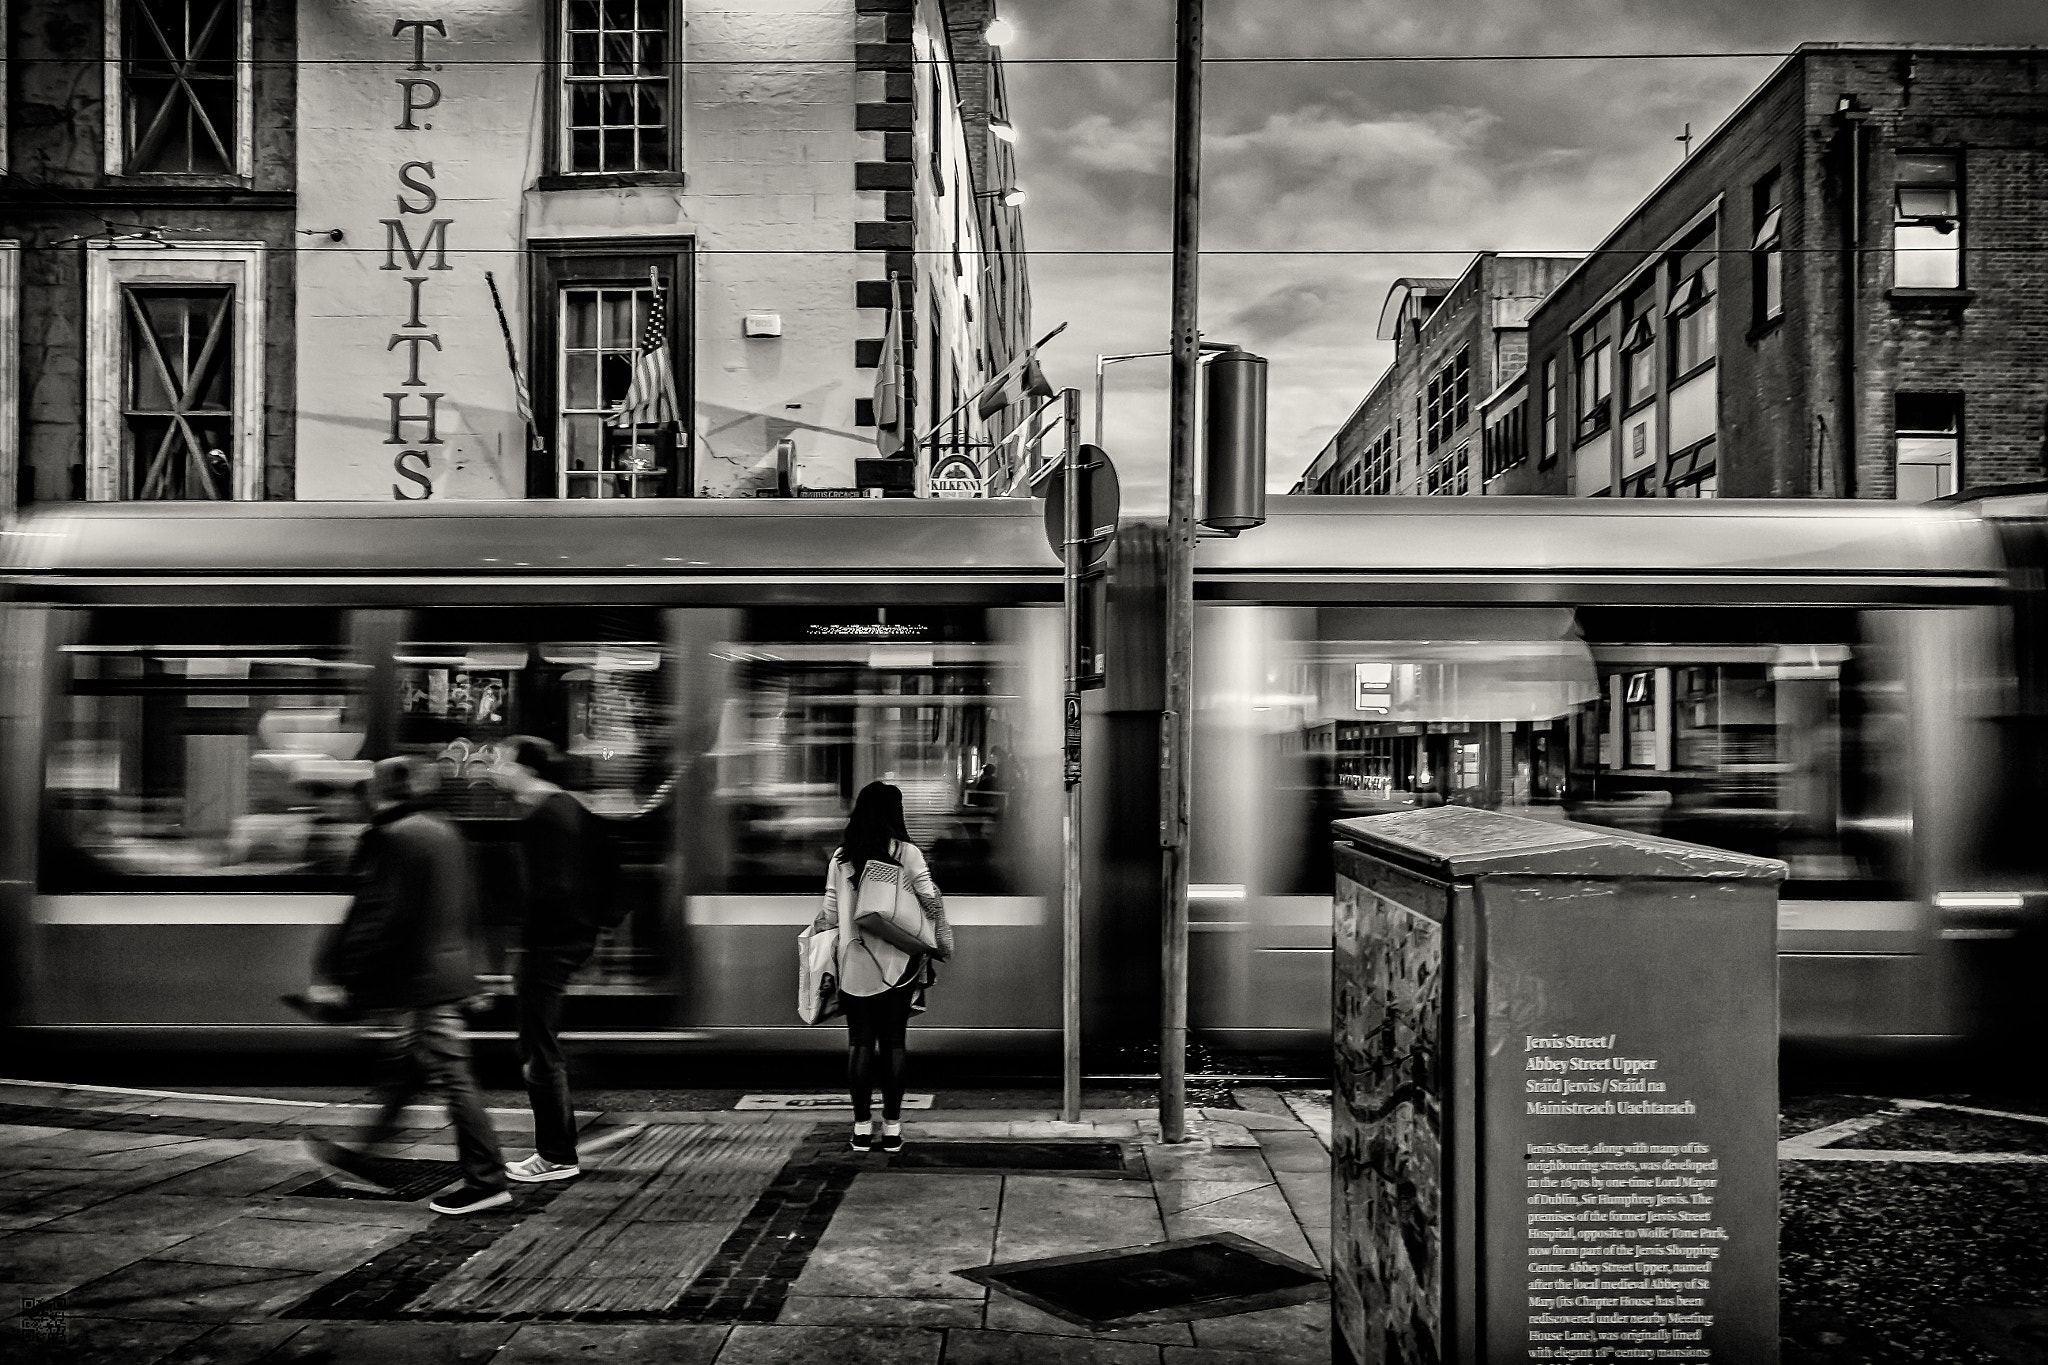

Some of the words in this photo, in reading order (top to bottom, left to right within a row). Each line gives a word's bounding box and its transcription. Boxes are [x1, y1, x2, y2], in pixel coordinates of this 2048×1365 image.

[379, 161, 454, 500] SMITHS
[931, 480, 981, 490] KILKENNY
[1525, 1034, 1565, 1051] Jervis
[1565, 1035, 1608, 1048] Street
[1526, 1056, 1569, 1074] Abbey
[1569, 1057, 1612, 1070] Street
[1612, 1057, 1657, 1074] Upper
[1526, 1078, 1562, 1093] Sráid
[1562, 1078, 1601, 1095] Jervis
[1609, 1078, 1646, 1092] Sráid
[1647, 1082, 1666, 1092] na
[1526, 1100, 1616, 1115] Mainistreach
[1617, 1100, 1696, 1115] Uachtarach
[1527, 1143, 1556, 1154] Jervis
[1593, 1143, 1624, 1156] along
[1624, 1143, 1649, 1153] with
[1650, 1145, 1679, 1156] many
[1680, 1143, 1694, 1153] of
[1694, 1143, 1710, 1153] its
[1527, 1159, 1600, 1173] neighbouring
[1662, 1159, 1718, 1173] developed
[1527, 1177, 1538, 1187] in
[1540, 1177, 1559, 1187] the
[1592, 1177, 1604, 1190] by
[1655, 1176, 1682, 1187] Lord
[1682, 1177, 1718, 1190] Mayor
[1527, 1193, 1541, 1204] of
[1582, 1193, 1597, 1204] Sir
[1598, 1193, 1656, 1207] Humphrey
[1690, 1193, 1713, 1204] The
[1527, 1211, 1576, 1224] premises
[1577, 1211, 1591, 1221] of
[1590, 1210, 1608, 1221] the
[1609, 1211, 1646, 1221] former
[1646, 1210, 1678, 1223] Jervis
[1678, 1211, 1712, 1221] Street
[1577, 1227, 1624, 1241] opposite
[1624, 1229, 1637, 1238] to
[1637, 1227, 1670, 1238] Wolfe
[1670, 1228, 1699, 1238] Tone
[1528, 1247, 1551, 1255] now
[1552, 1245, 1578, 1255] form
[1579, 1246, 1602, 1258] part
[1602, 1245, 1616, 1255] of
[1616, 1245, 1634, 1255] the
[1634, 1244, 1665, 1257] Jervis
[1665, 1244, 1720, 1258] Shopping
[1568, 1262, 1601, 1275] Abbey
[1602, 1262, 1634, 1272] Street
[1673, 1262, 1712, 1272] named
[1528, 1278, 1553, 1290] after
[1554, 1278, 1573, 1290] the
[1573, 1278, 1600, 1290] local
[1600, 1278, 1650, 1290] medieval
[1650, 1278, 1684, 1292] Abbey
[1684, 1278, 1698, 1289] of
[1575, 1296, 1619, 1309] Chapter
[1619, 1297, 1655, 1306] House
[1655, 1296, 1675, 1306] has
[1676, 1296, 1704, 1306] been
[1529, 1312, 1596, 1323] rediscovered
[1596, 1312, 1629, 1323] under
[1630, 1312, 1667, 1326] nearby
[1667, 1312, 1714, 1326] Meeting
[1529, 1330, 1563, 1340] House
[1620, 1329, 1671, 1343] originally
[1672, 1329, 1702, 1340] lined
